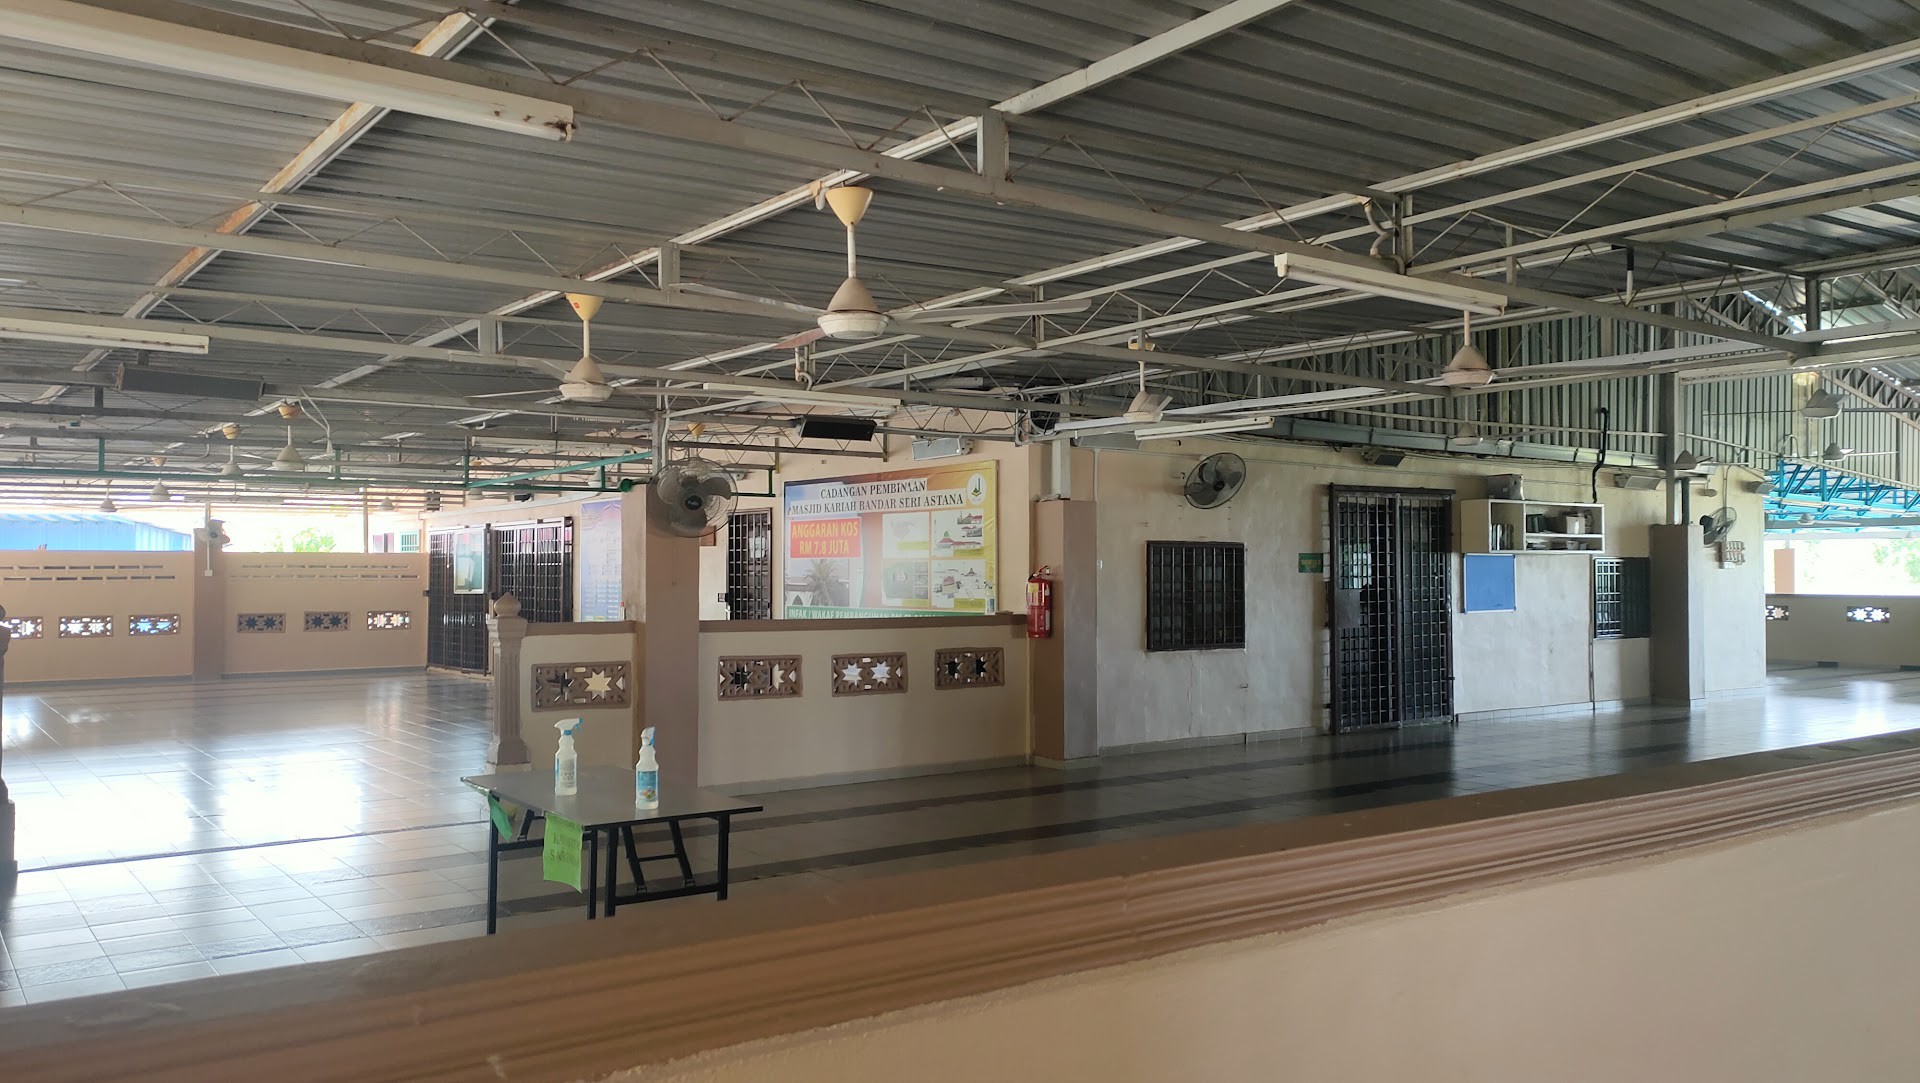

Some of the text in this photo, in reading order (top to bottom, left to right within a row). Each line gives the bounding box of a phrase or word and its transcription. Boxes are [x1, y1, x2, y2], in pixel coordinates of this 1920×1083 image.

[821, 481, 926, 499] CADANGAN PEMBINAAN
[792, 493, 964, 515] MASJID KARIAH BANDAR SERI ASTANA
[792, 521, 858, 539] ANGGARAN KOS
[799, 539, 850, 555] RM 7.8 JUTA
[788, 608, 807, 619] INFAK
[812, 609, 834, 619] WAKAF
